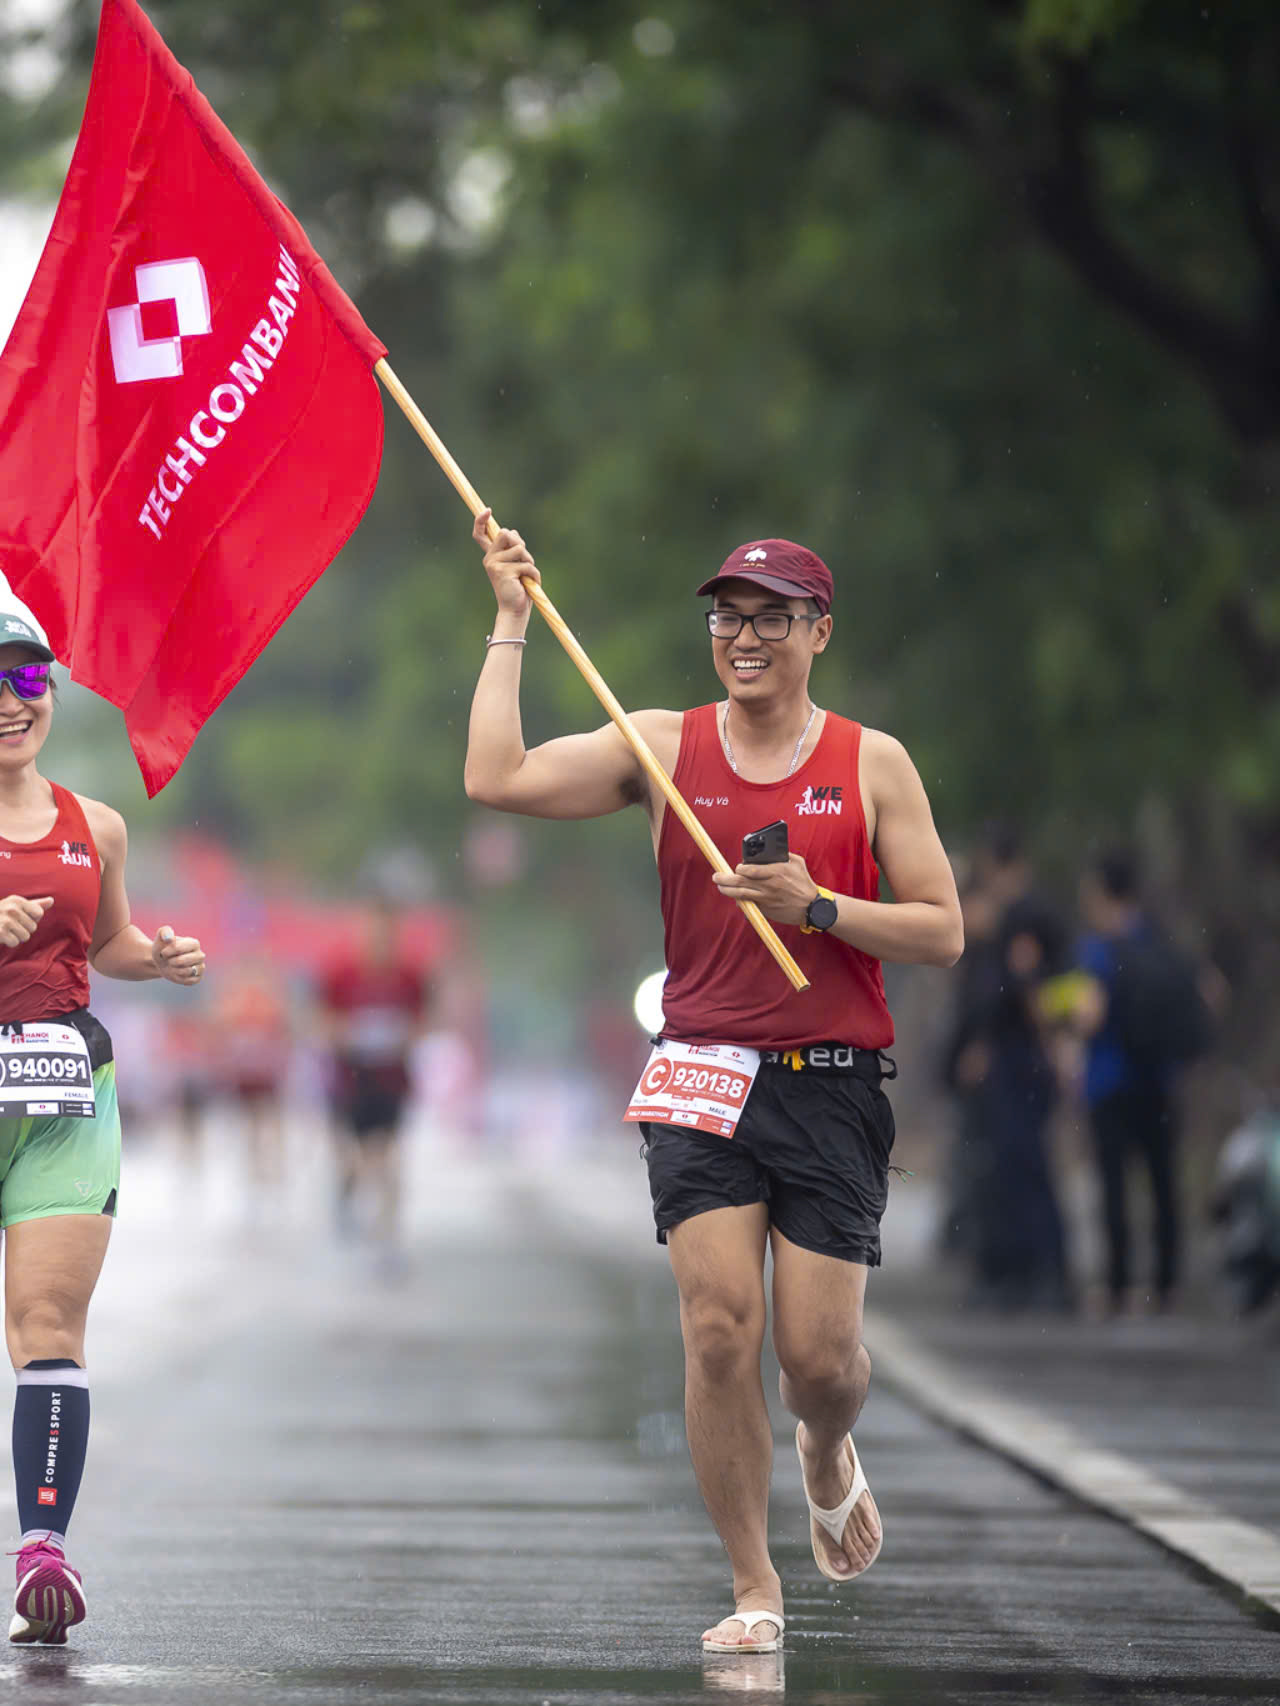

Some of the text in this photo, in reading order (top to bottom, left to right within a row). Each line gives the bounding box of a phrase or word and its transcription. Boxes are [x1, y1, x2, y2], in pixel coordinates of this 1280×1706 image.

[811, 786, 843, 800] WE
[694, 796, 714, 807] Huy
[798, 800, 842, 815] RUN
[69, 841, 89, 855] WE
[61, 853, 92, 868] RUN
[8, 1057, 87, 1080] 940091
[646, 1065, 667, 1089] C
[673, 1067, 746, 1099] 920138
[708, 1106, 728, 1116] MALE
[44, 1391, 61, 1484] COMPRESSPORT
